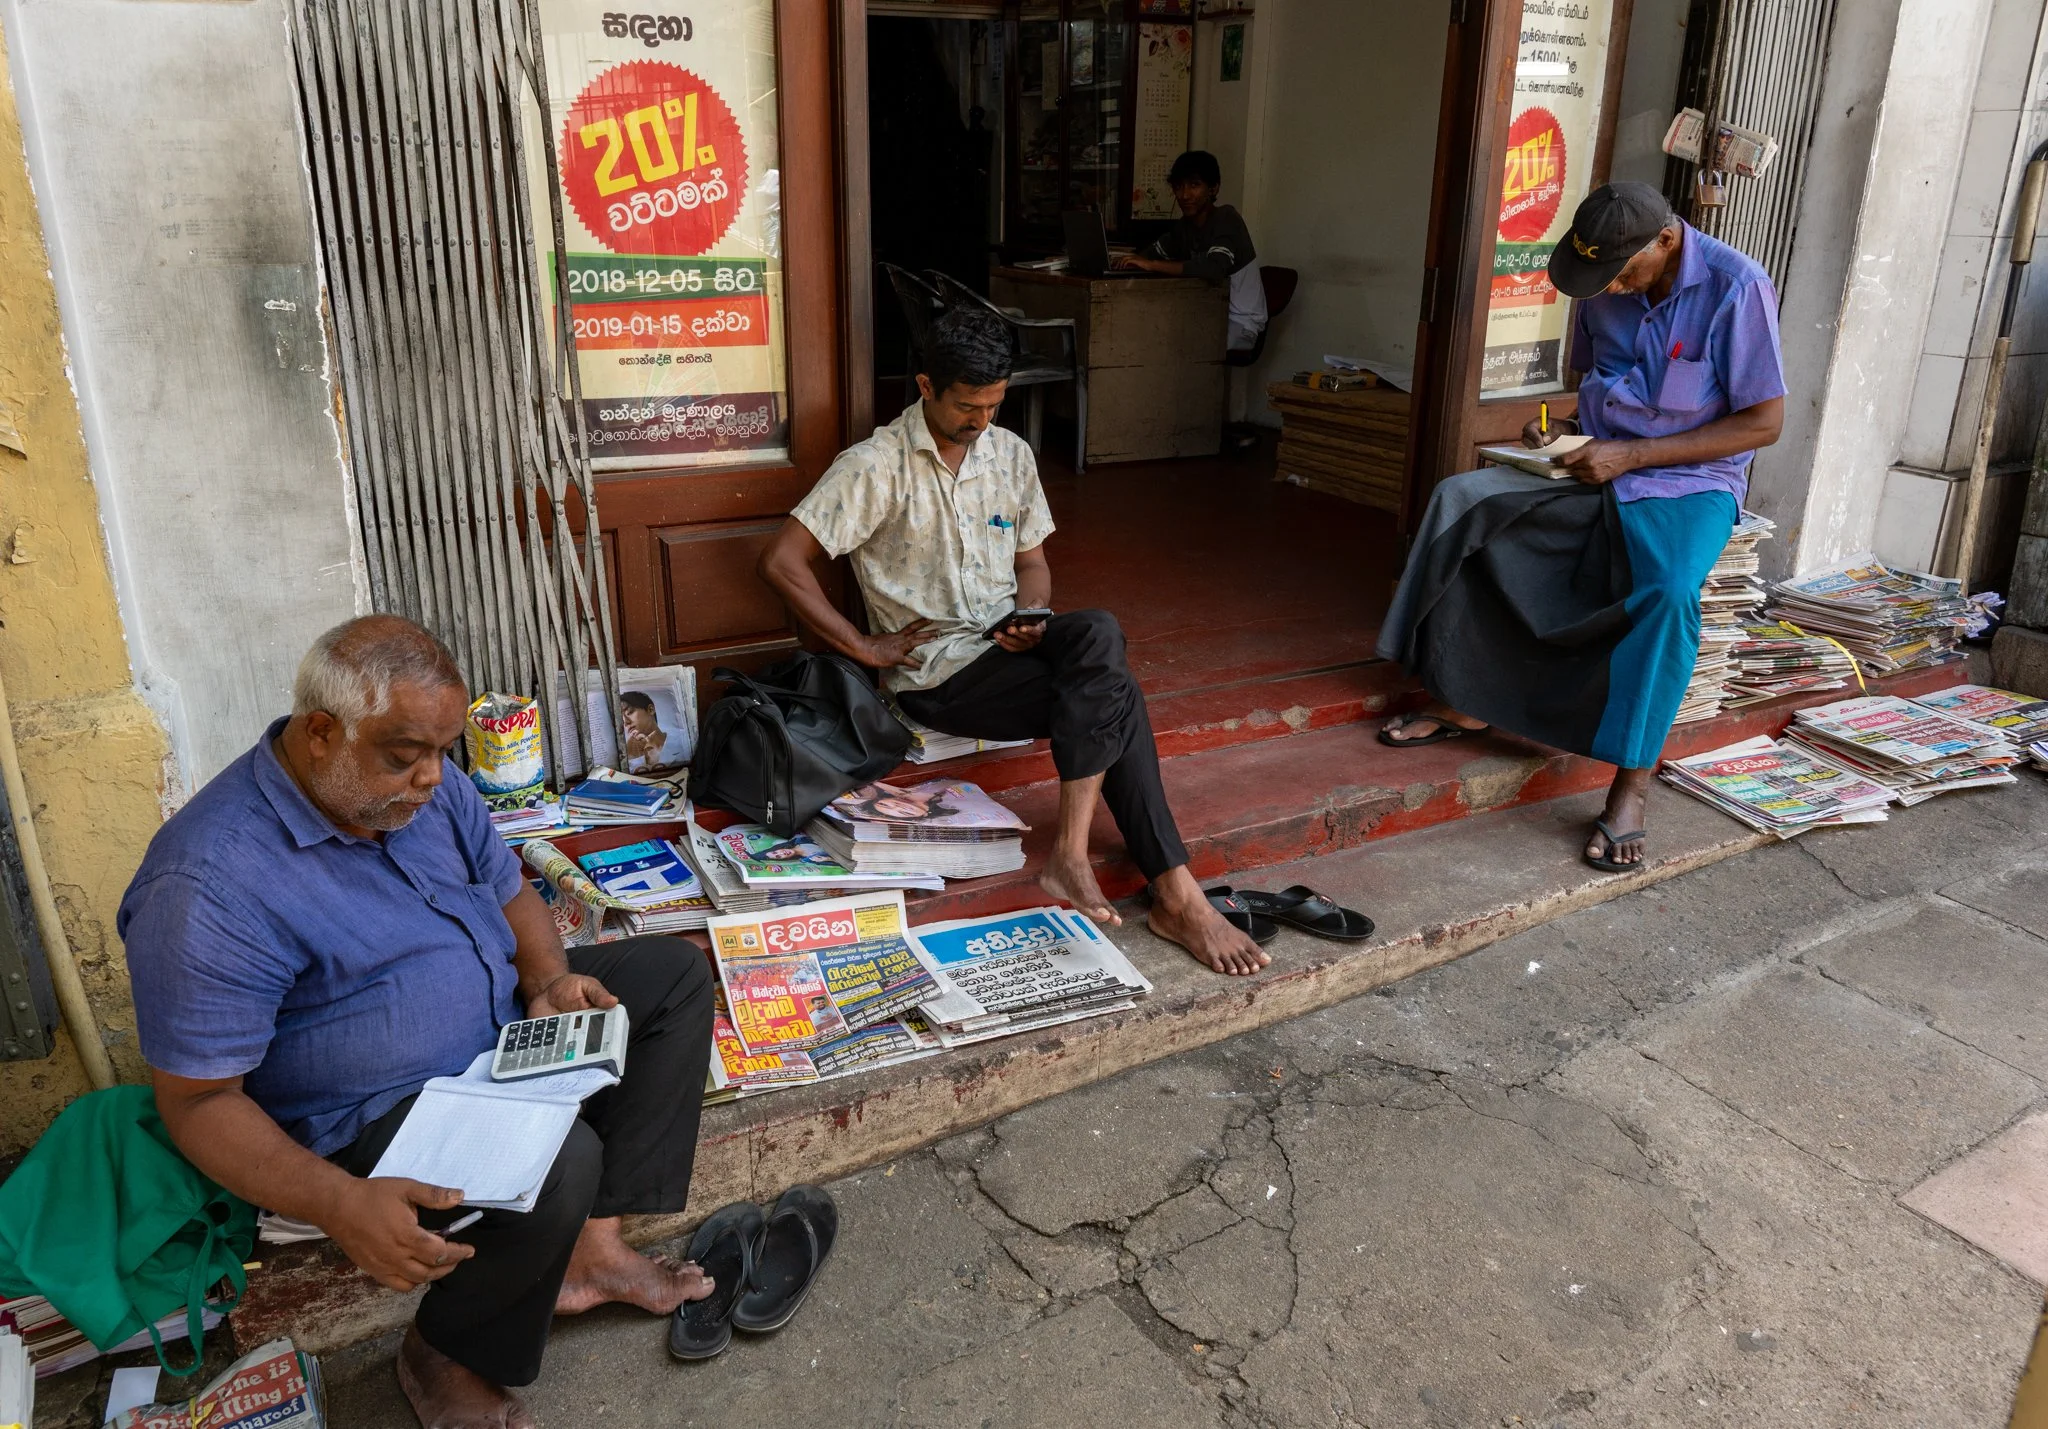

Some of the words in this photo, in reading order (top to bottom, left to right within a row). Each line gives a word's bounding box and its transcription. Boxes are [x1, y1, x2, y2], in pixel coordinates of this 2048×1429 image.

[601, 12, 693, 48] සඳහා
[579, 92, 718, 198] 20%
[1504, 128, 1555, 203] 20%
[607, 167, 728, 232] වට්ටමක්
[568, 269, 702, 294] 2018-12-05
[713, 267, 755, 292] සිට
[574, 314, 682, 338] 2019-01-15
[691, 310, 750, 338] දක්වා
[618, 354, 672, 366] කොන්දේසි
[676, 353, 713, 364] සහිතයි
[716, 422, 770, 438] මහනුවර
[1717, 758, 1777, 774] දිවයින
[766, 917, 856, 951] දිවයින
[966, 925, 1057, 958] අනිද්දා
[946, 967, 978, 981] මූලික
[979, 951, 1047, 972] අයිතිවාසිකම්
[957, 972, 998, 988] තොග
[1000, 959, 1054, 979] ගණනින්
[268, 1359, 291, 1380] is
